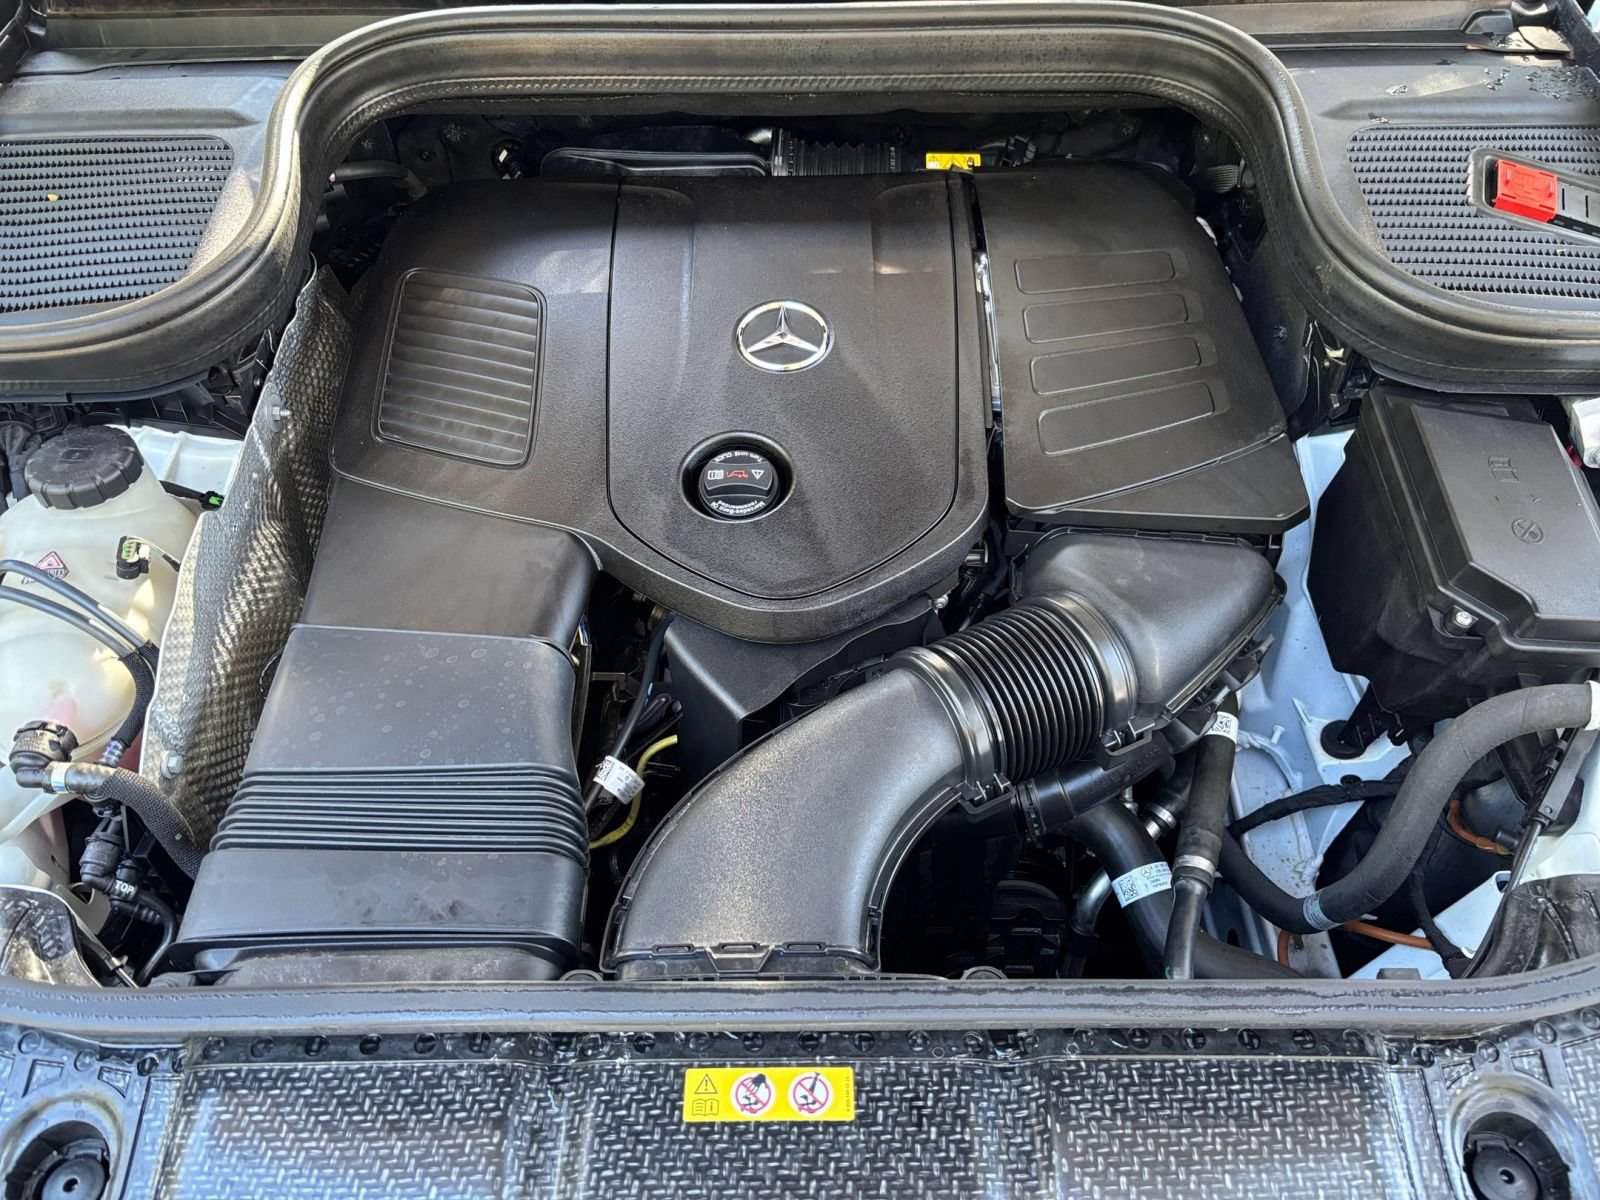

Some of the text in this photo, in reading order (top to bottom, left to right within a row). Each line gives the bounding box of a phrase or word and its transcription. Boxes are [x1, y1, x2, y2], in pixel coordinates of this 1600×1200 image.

[713, 452, 732, 462] CLICK
[750, 453, 762, 462] Turn
[717, 500, 758, 509] recommended
[718, 500, 765, 514] Mercedes-Benz
[115, 879, 135, 894] TOP
